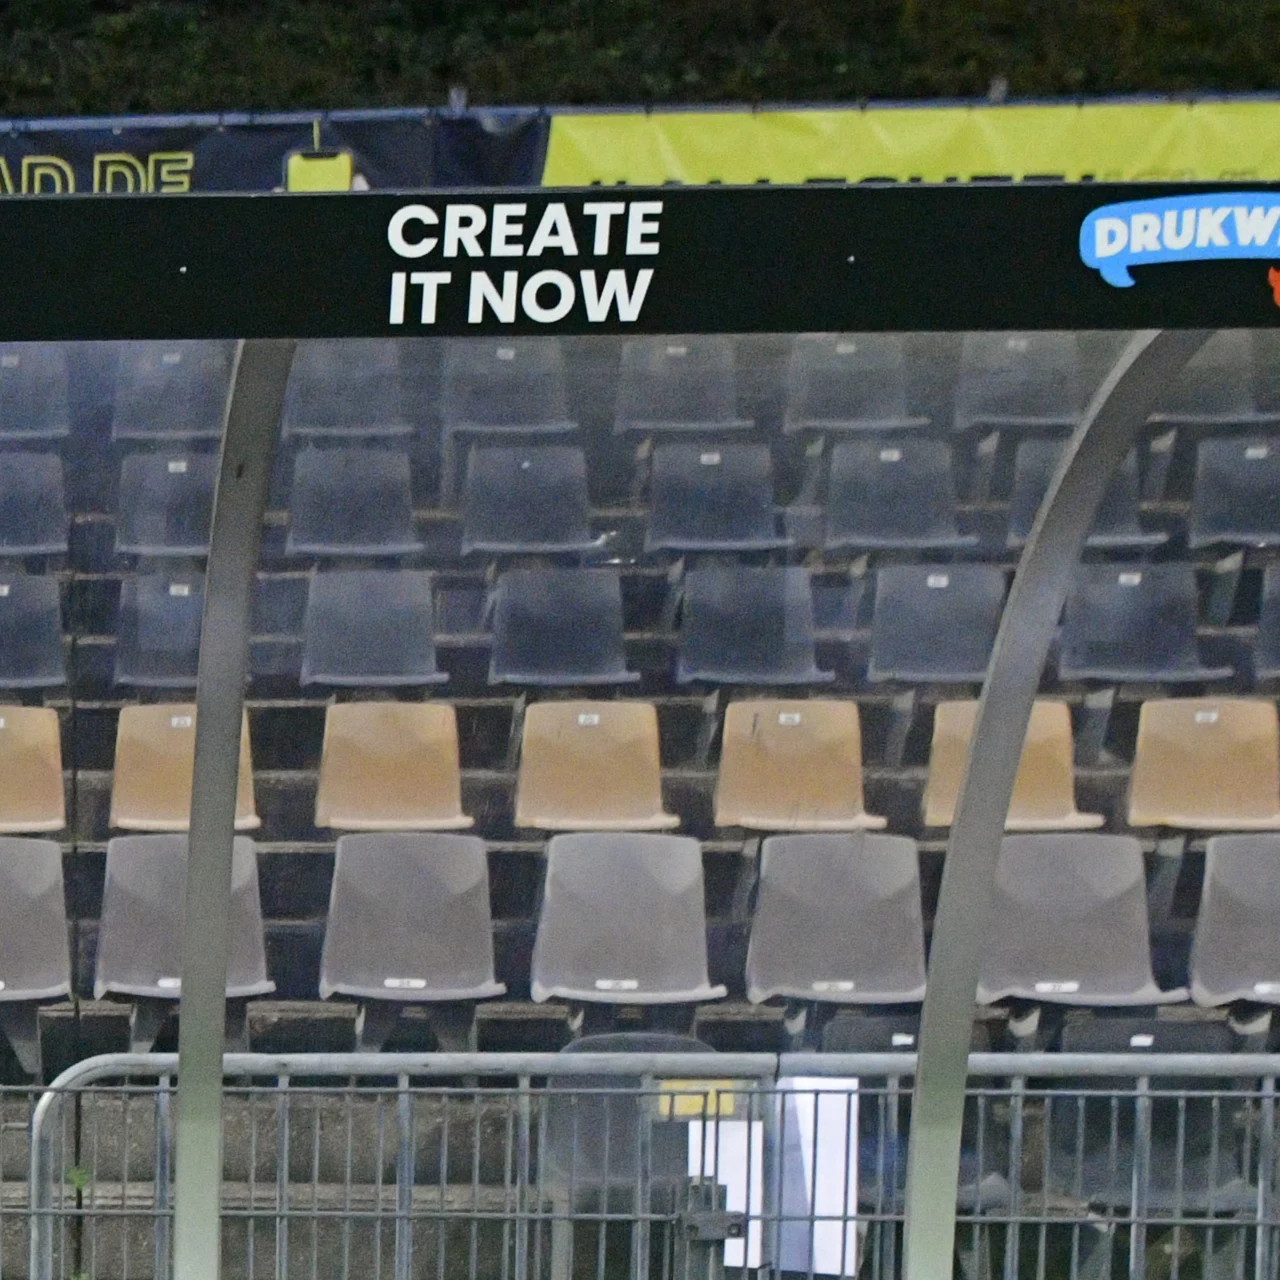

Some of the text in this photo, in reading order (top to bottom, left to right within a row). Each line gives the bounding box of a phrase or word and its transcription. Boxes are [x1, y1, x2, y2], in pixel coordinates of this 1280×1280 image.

[387, 200, 665, 258] CREATE
[1095, 206, 1280, 259] DRUKW
[388, 267, 654, 325] IT NOW
